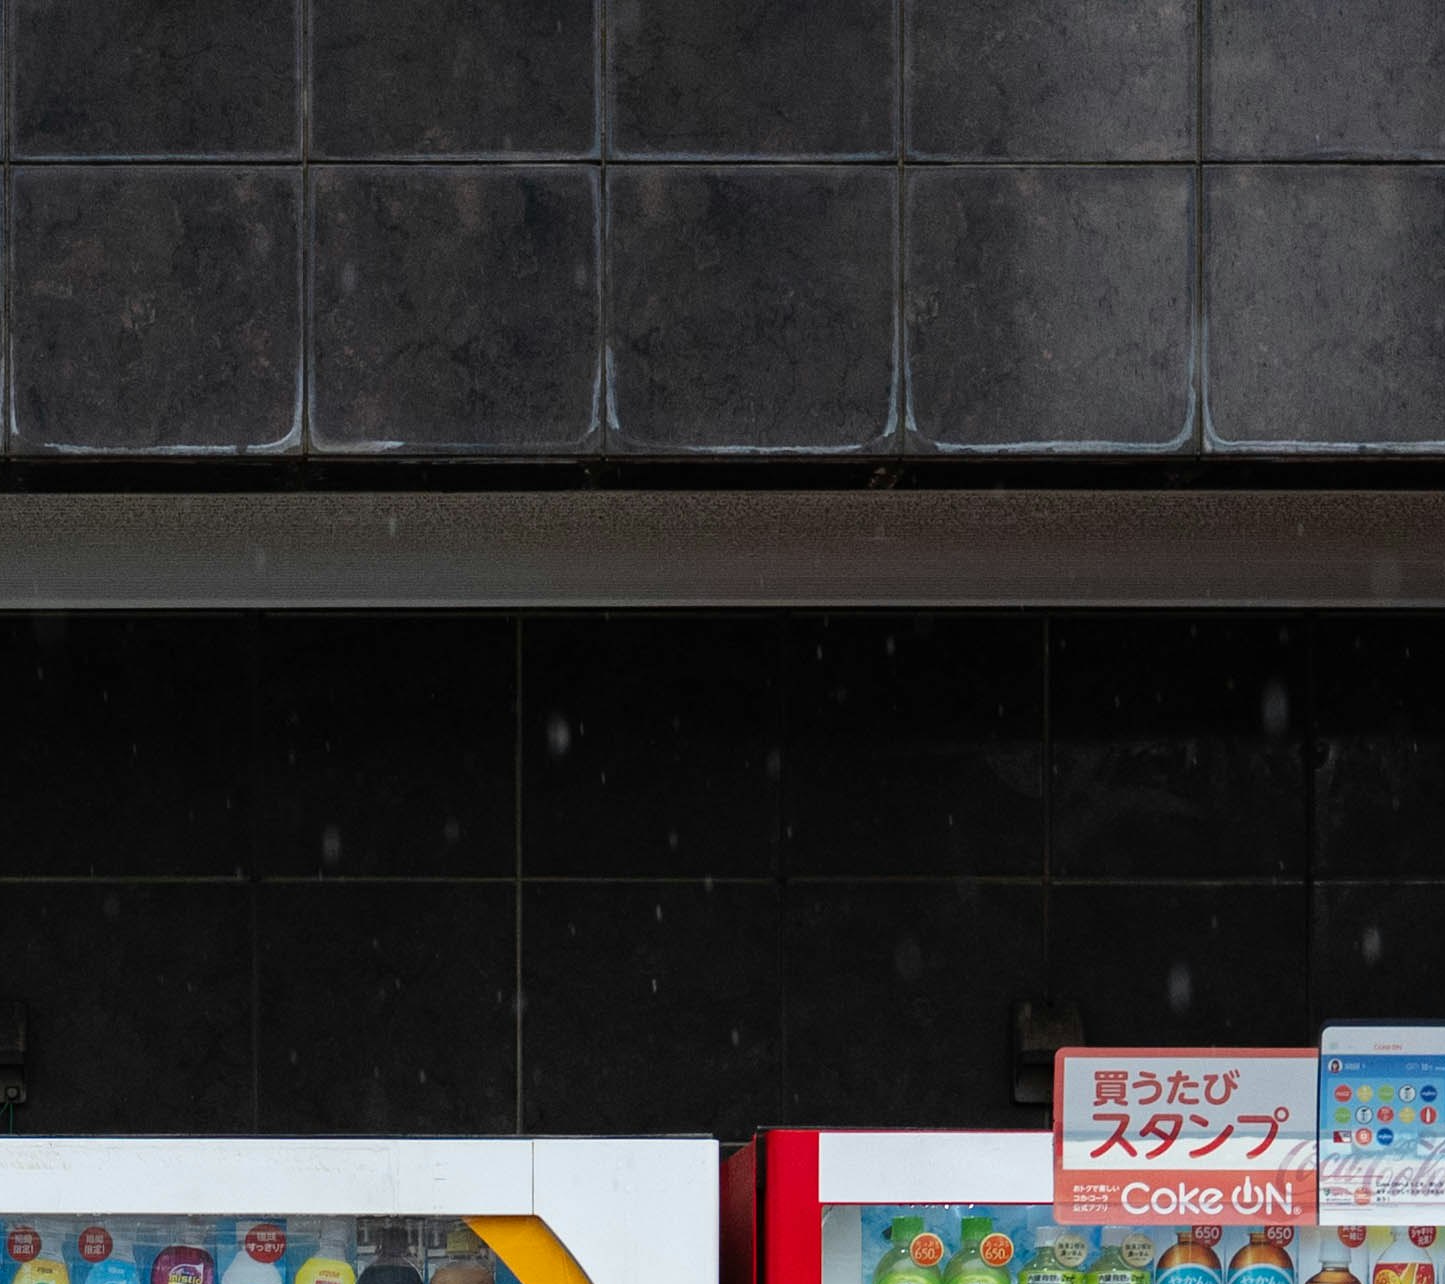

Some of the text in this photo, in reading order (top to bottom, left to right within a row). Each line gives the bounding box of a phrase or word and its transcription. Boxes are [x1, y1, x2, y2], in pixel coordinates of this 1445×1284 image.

[1093, 1069, 1240, 1107] 買うたび
[1090, 1107, 1289, 1160] スタンプ
[1121, 1182, 1223, 1215] Coke
[246, 1241, 284, 1252] すっきり!
